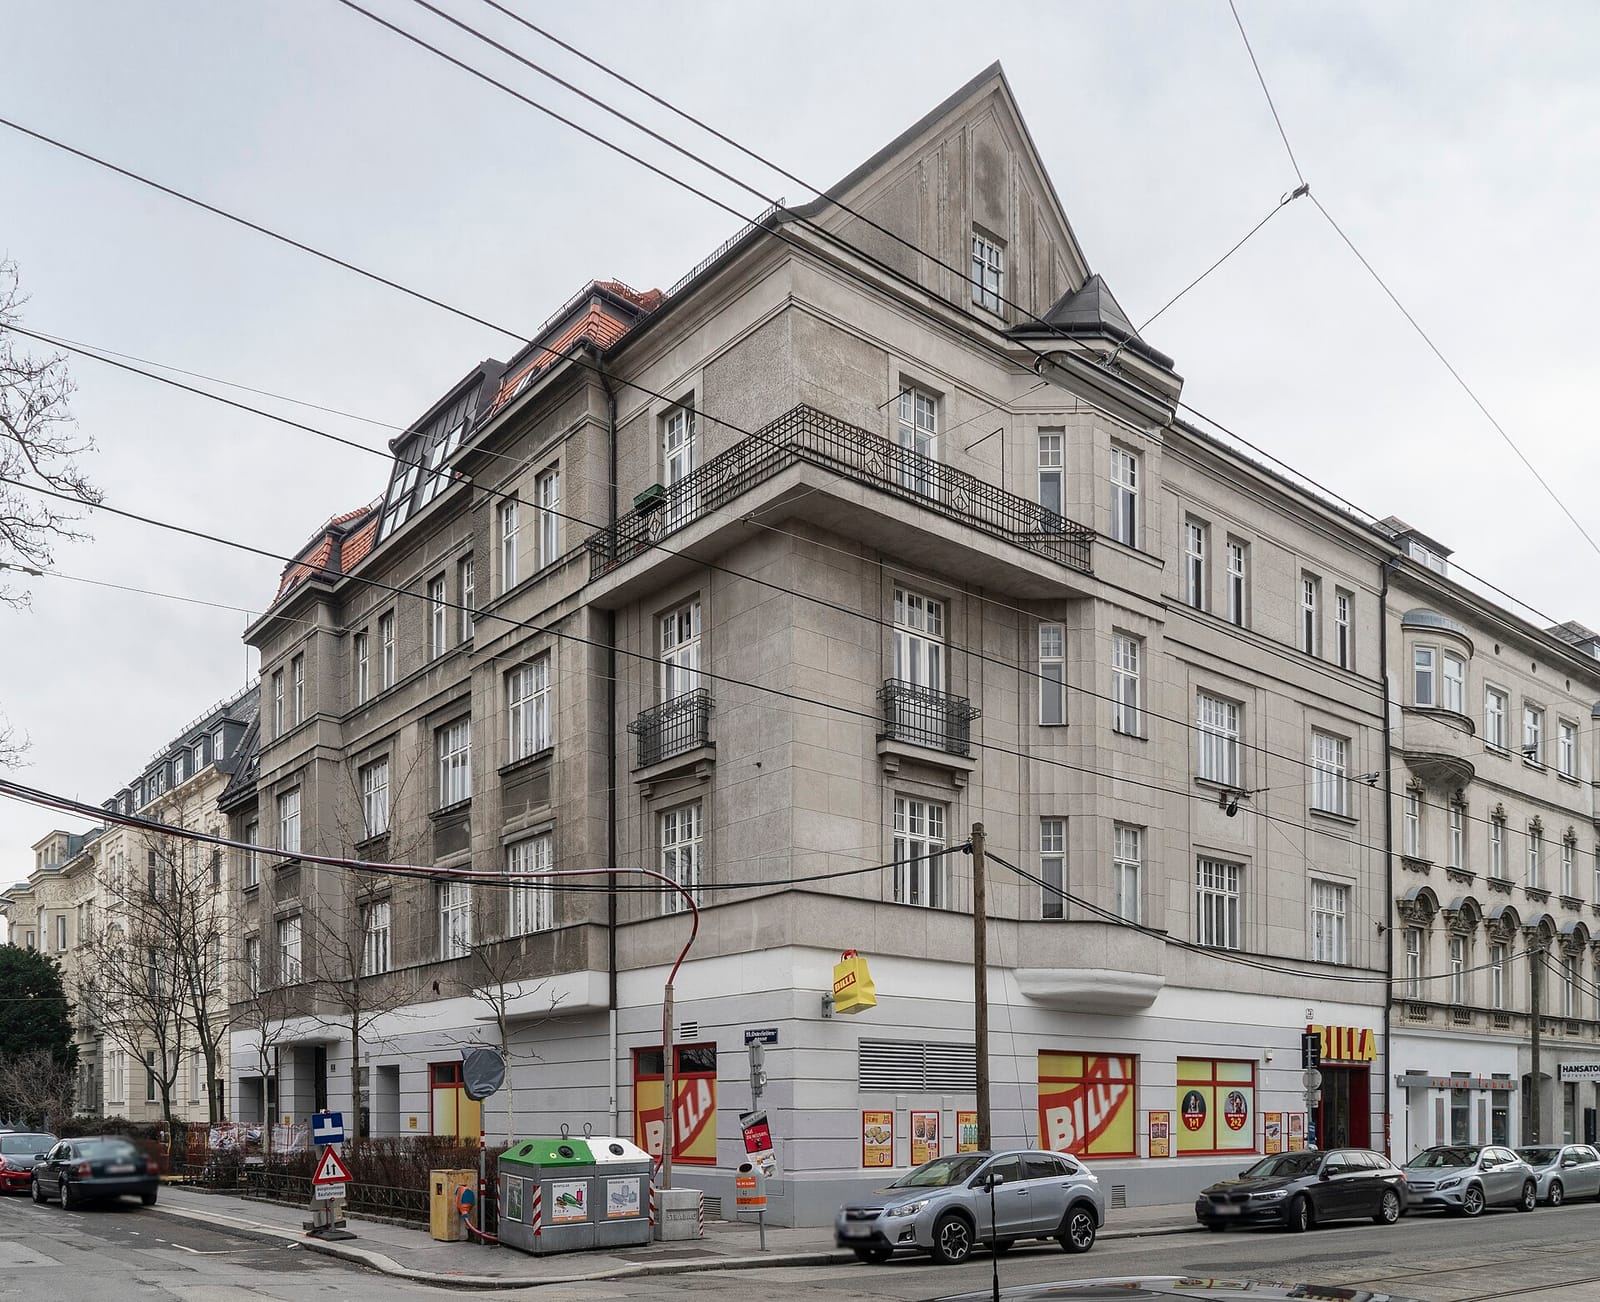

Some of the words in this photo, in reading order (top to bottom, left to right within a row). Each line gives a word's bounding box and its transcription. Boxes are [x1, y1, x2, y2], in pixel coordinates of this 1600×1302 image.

[835, 973, 855, 990] BILLA
[1562, 1065, 1600, 1073] HANSATO
[1046, 1058, 1126, 1151] BILLA
[645, 1079, 712, 1156] BLLA
[1189, 1117, 1199, 1128] 1+1
[1230, 1117, 1242, 1127] 2+2
